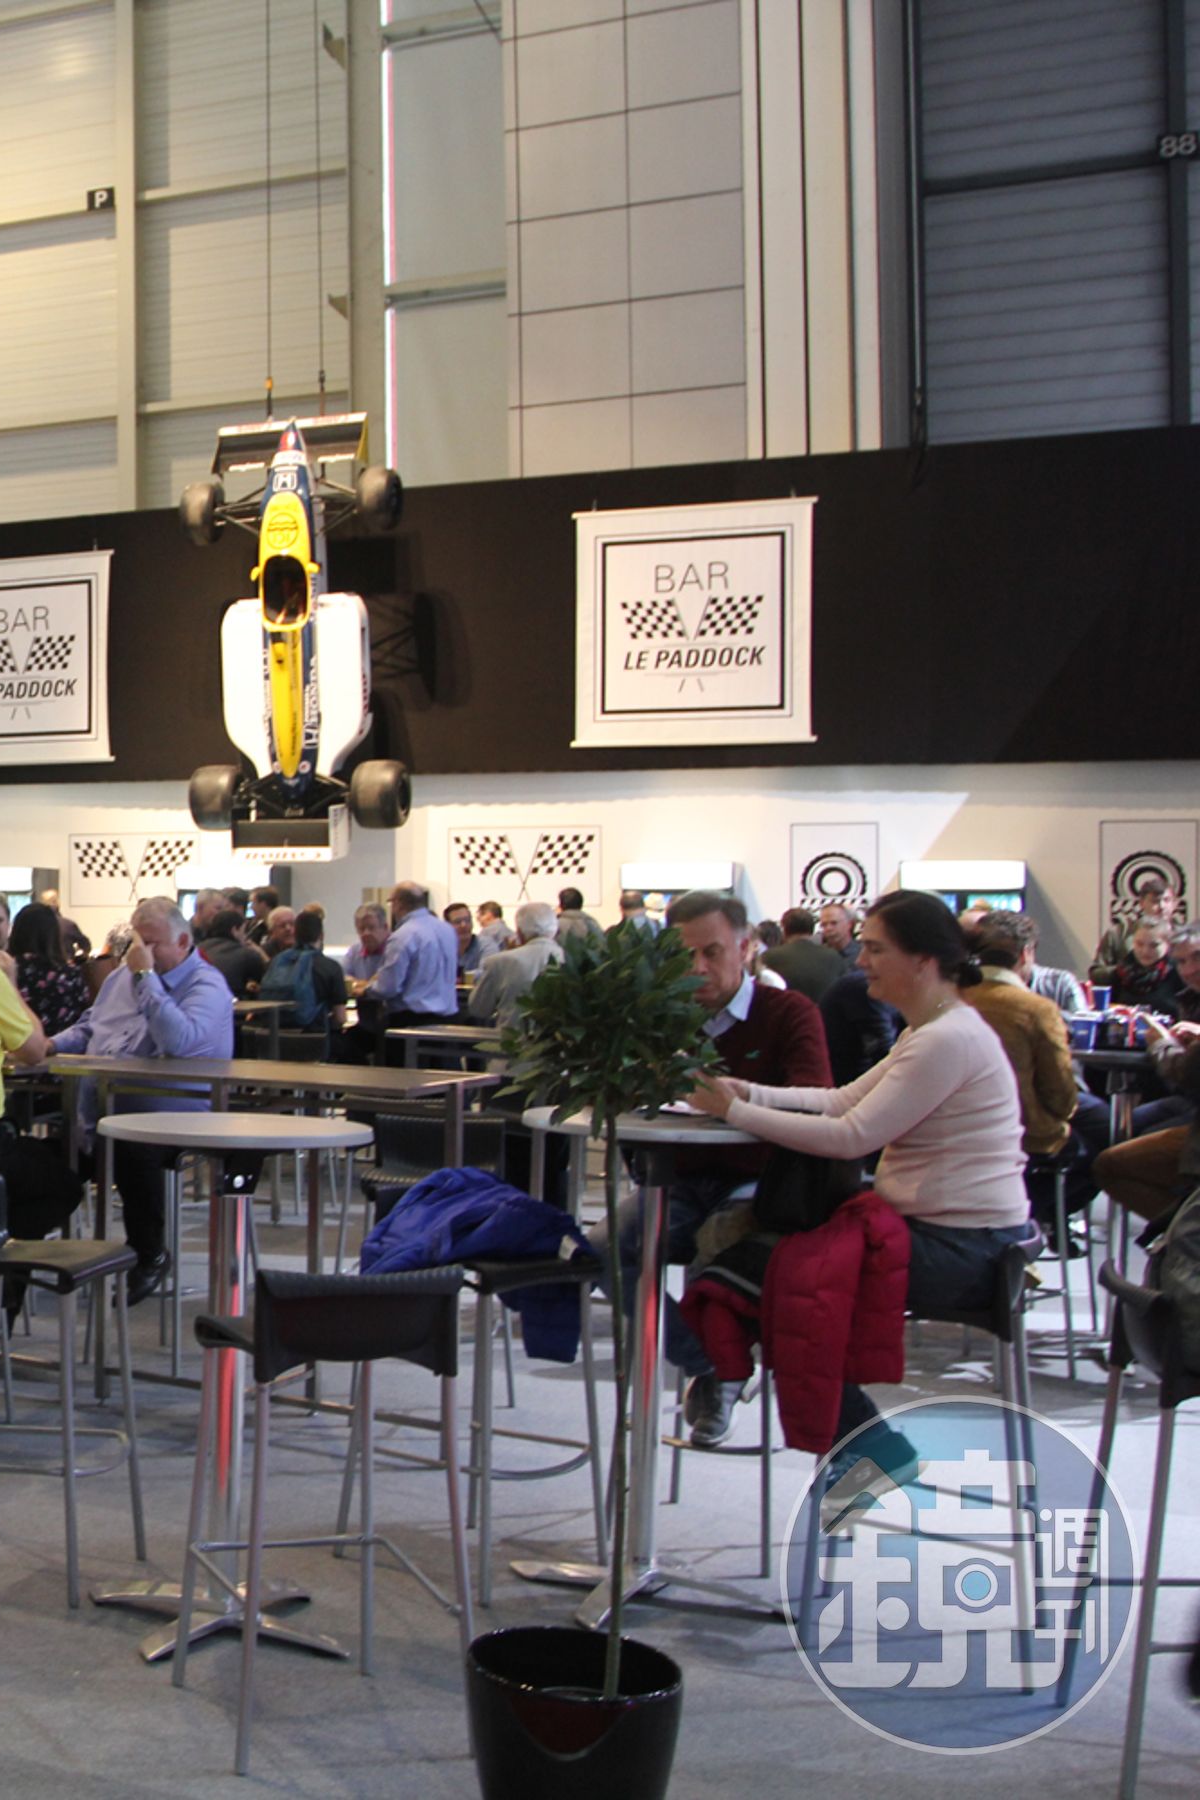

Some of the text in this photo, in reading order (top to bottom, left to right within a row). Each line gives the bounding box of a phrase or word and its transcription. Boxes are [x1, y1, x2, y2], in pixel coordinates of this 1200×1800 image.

[1160, 133, 1197, 157] 88
[94, 190, 108, 209] P
[654, 561, 729, 593] BAR
[623, 646, 766, 671] LE PADDOCK
